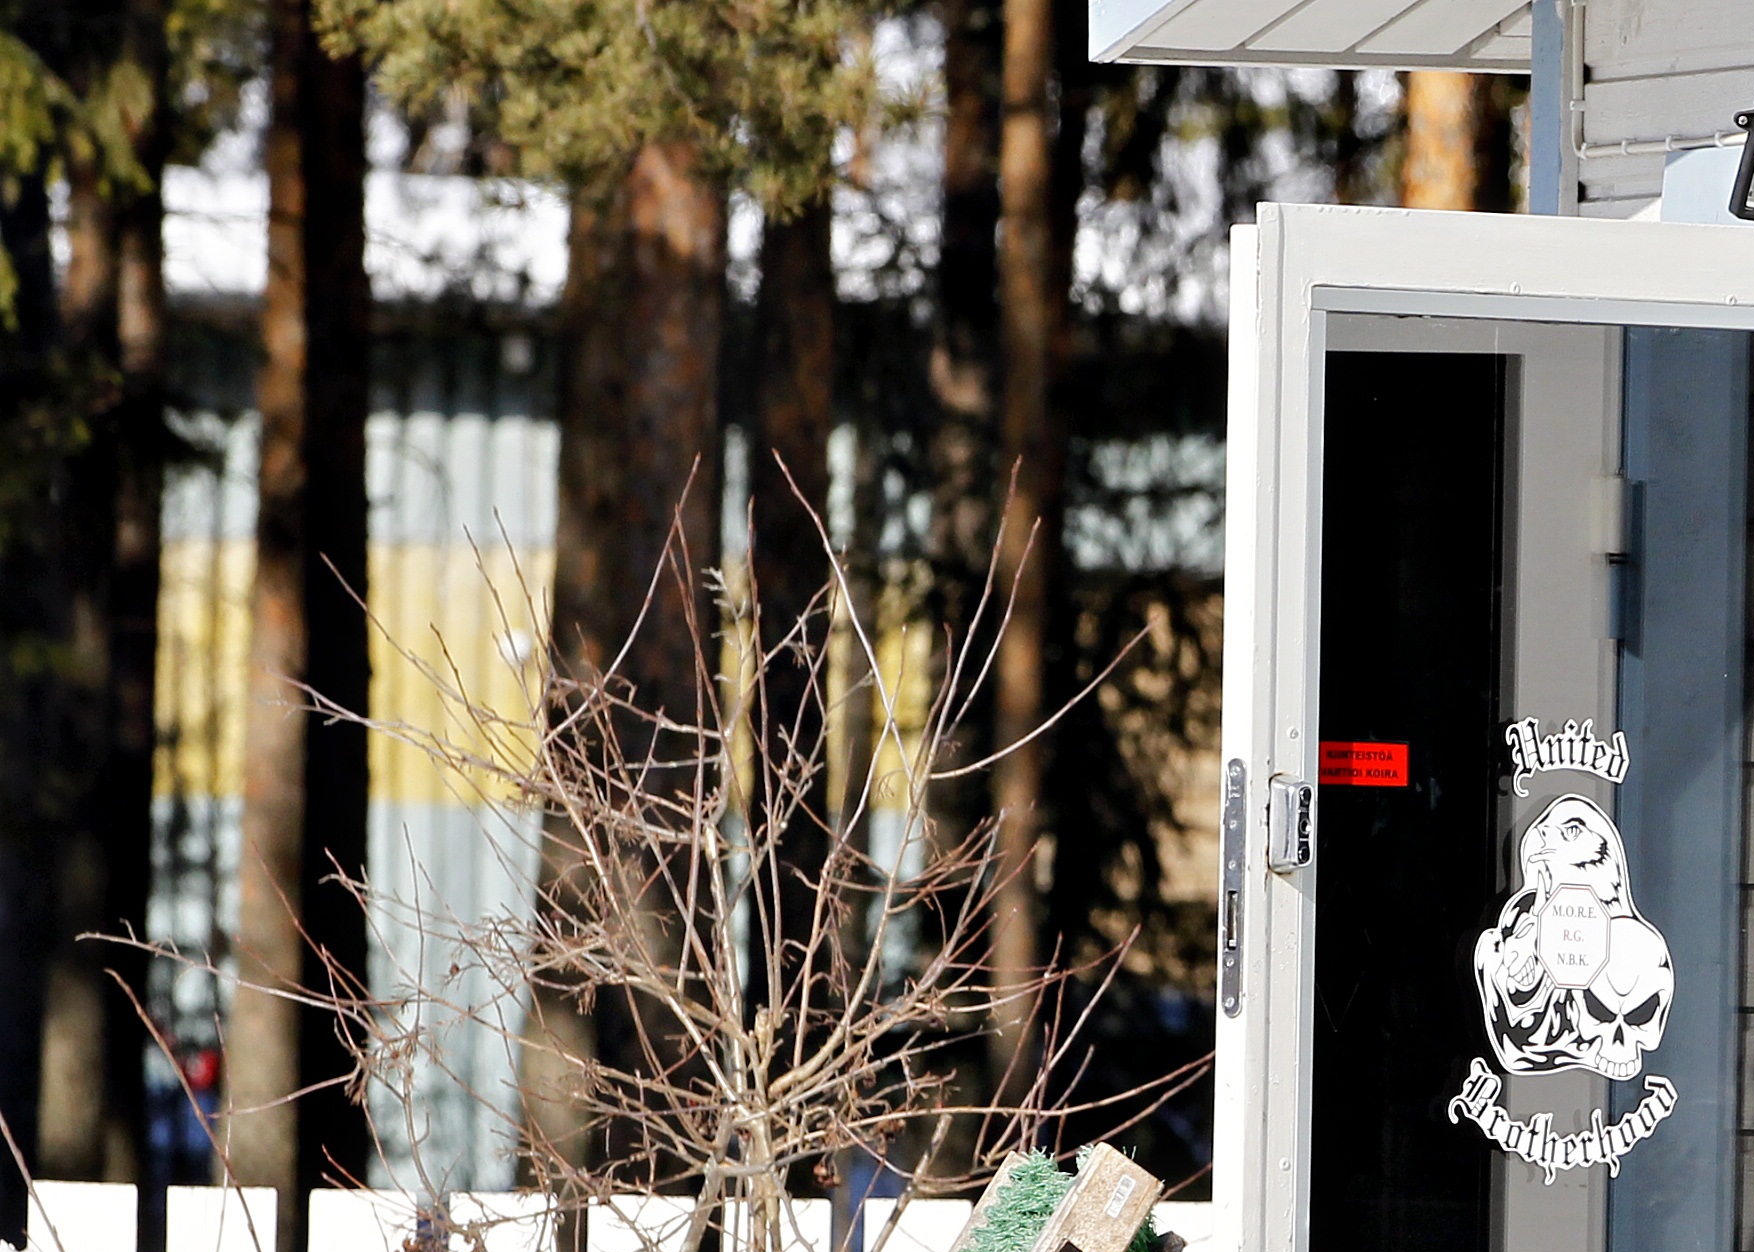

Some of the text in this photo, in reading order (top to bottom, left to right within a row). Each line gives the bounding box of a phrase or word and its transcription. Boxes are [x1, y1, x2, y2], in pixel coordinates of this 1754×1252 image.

[1506, 717, 1630, 797] United
[1366, 768, 1399, 779] KOIRA
[1552, 904, 1597, 919] M.O.R.E.
[1563, 929, 1584, 942] R.G.
[1557, 952, 1589, 966] N.B.K.
[1448, 1057, 1679, 1186] Brotherhood
